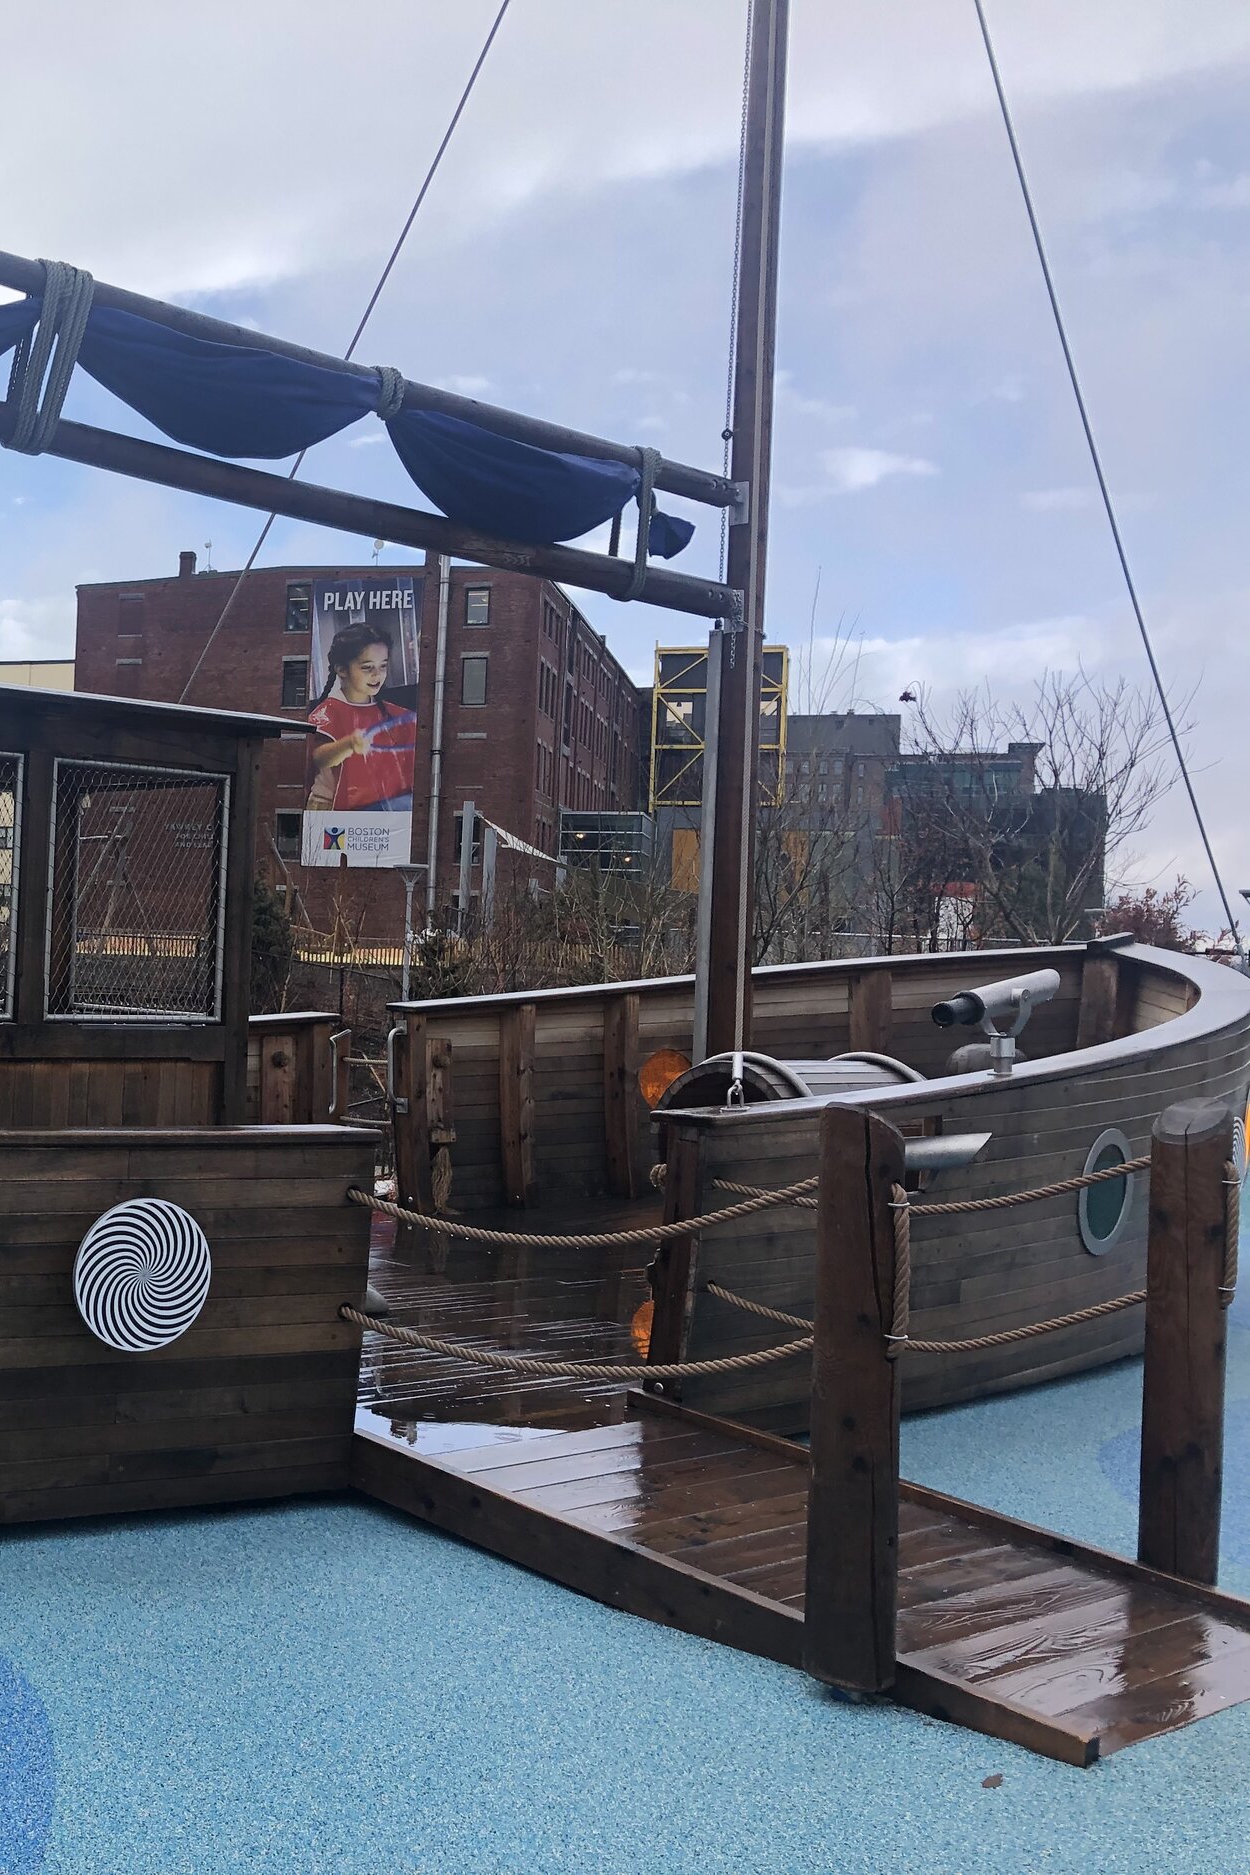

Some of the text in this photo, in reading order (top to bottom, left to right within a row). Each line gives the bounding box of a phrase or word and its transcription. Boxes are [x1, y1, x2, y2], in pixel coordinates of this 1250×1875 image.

[323, 589, 414, 611] PLAY HERE
[347, 827, 390, 836] BOSTON
[347, 842, 390, 851] MUSEUM
